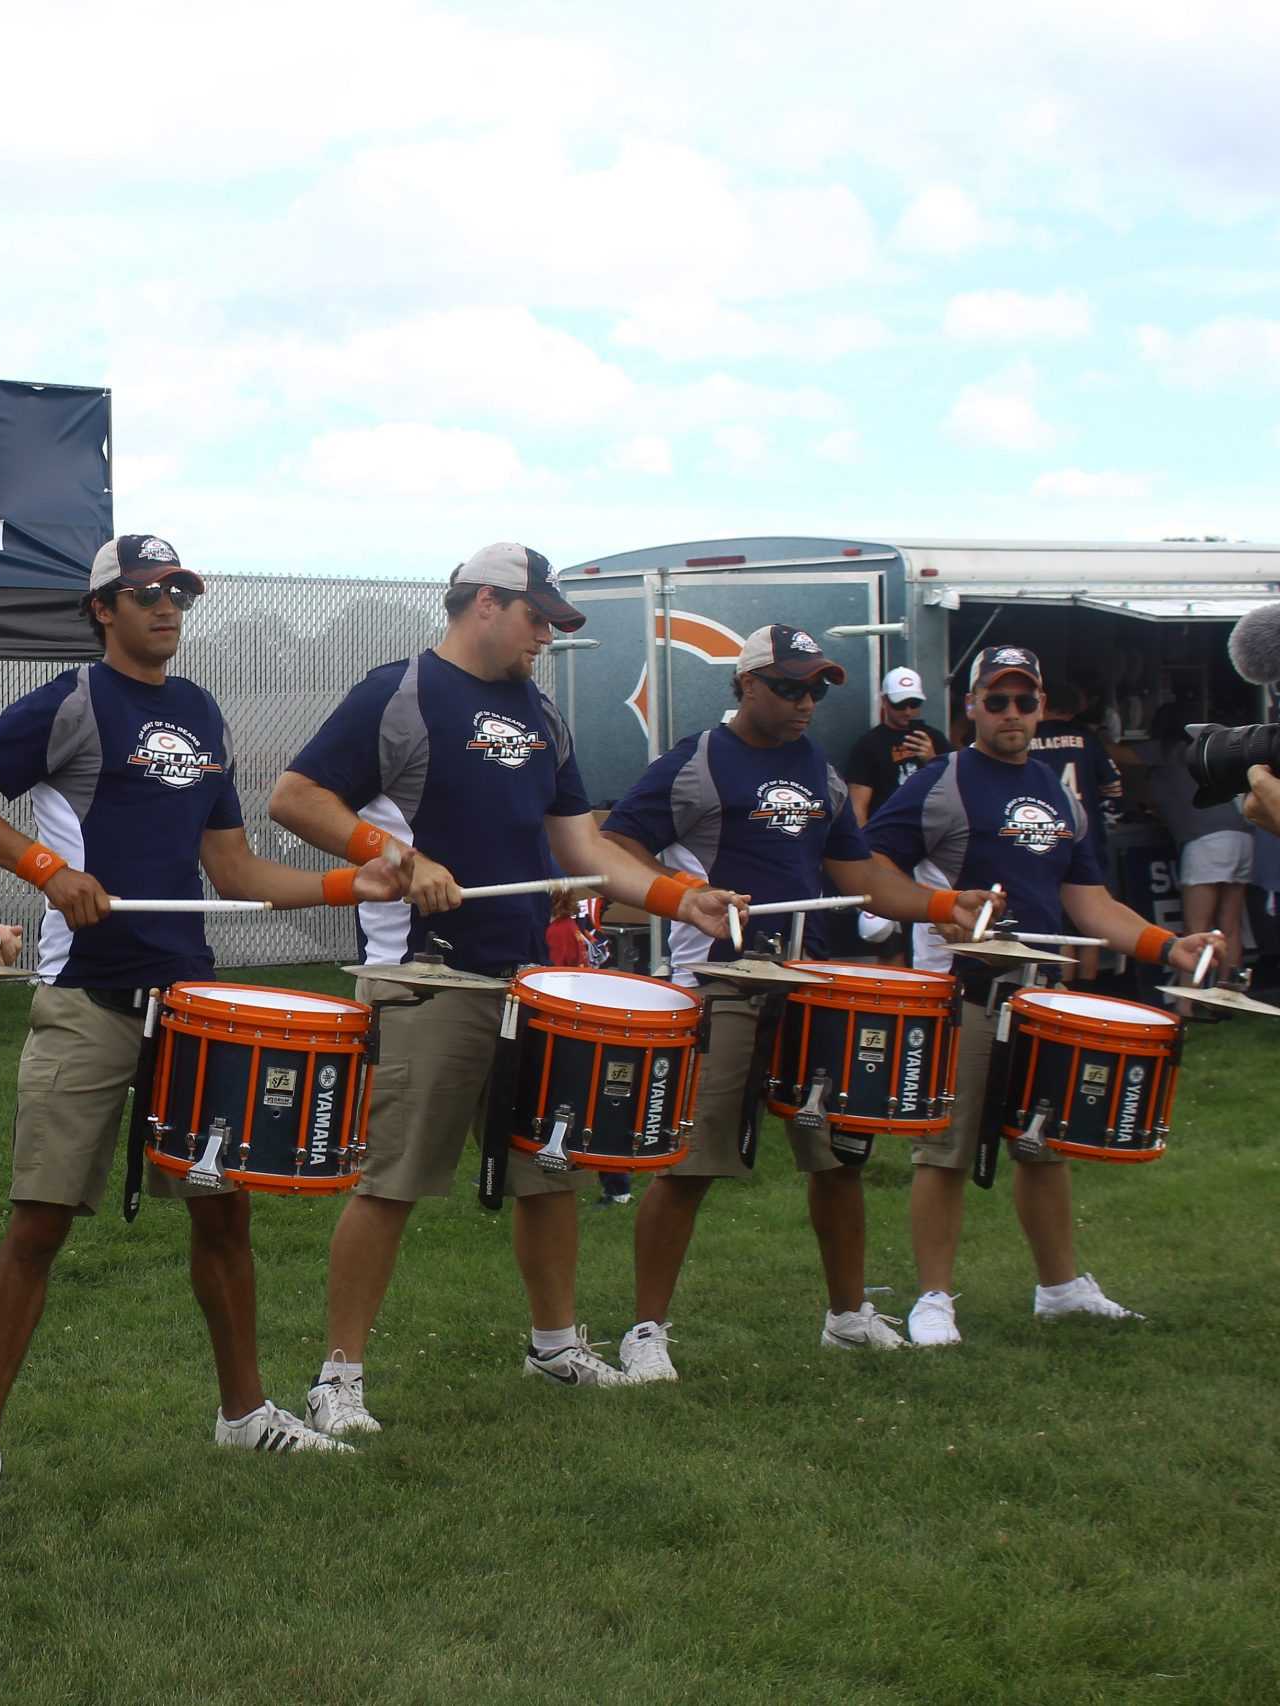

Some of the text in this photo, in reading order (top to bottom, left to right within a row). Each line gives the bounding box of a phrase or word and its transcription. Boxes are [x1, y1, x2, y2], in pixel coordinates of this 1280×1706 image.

[1028, 735, 1084, 750] RLACHER
[137, 748, 208, 765] DRUM
[487, 747, 531, 757] LINE
[149, 764, 201, 777] LINE
[771, 815, 808, 825] LINE
[1019, 834, 1057, 844] LINE
[901, 1049, 922, 1112] YAMAHA
[644, 1080, 667, 1146] YAMAHA
[1117, 1085, 1141, 1142] YAMAHA
[310, 1091, 336, 1165] YAMAHA
